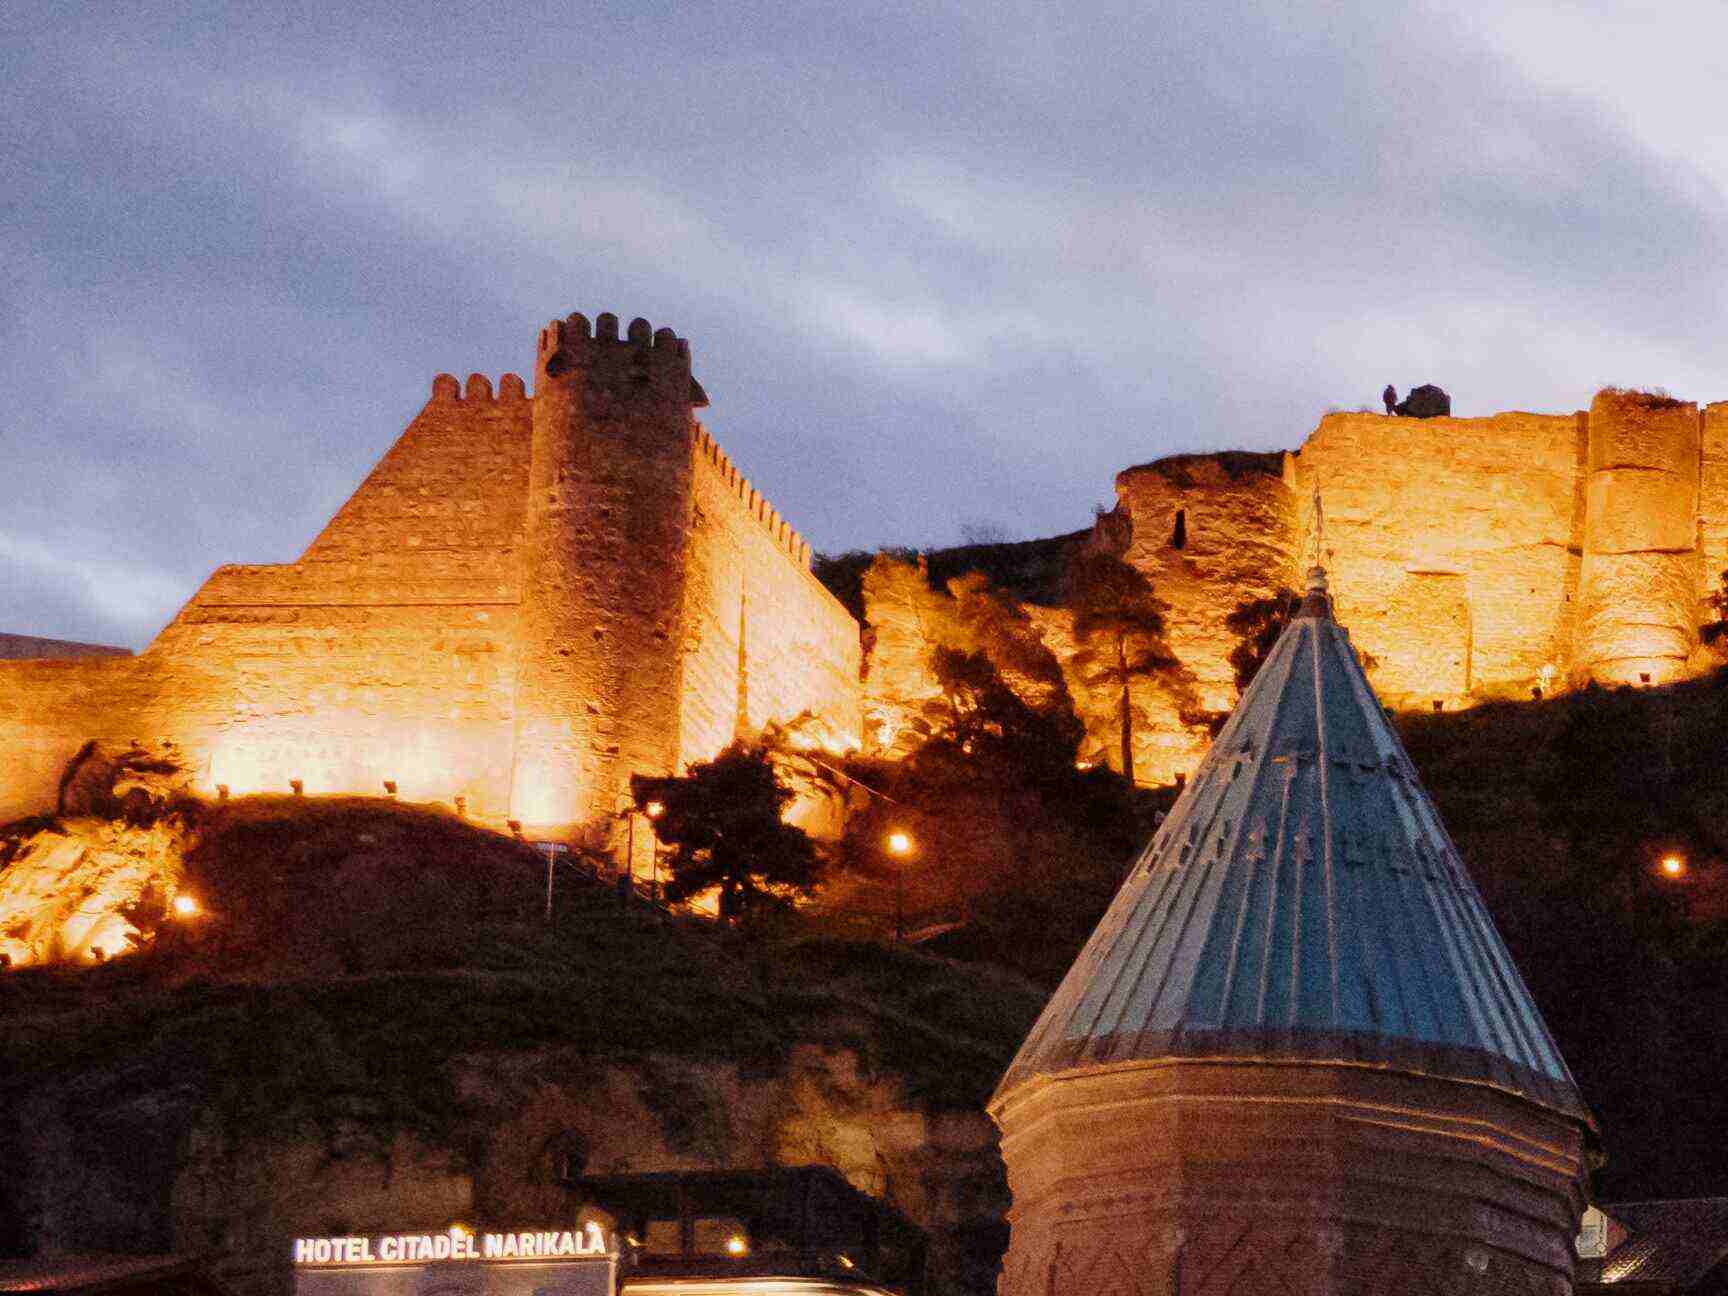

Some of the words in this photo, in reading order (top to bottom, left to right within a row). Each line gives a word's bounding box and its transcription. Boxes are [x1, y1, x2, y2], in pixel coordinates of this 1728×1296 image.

[296, 1237, 375, 1262] HOTEL
[380, 1234, 480, 1260] CITADEL
[485, 1231, 606, 1257] NARIKALA
